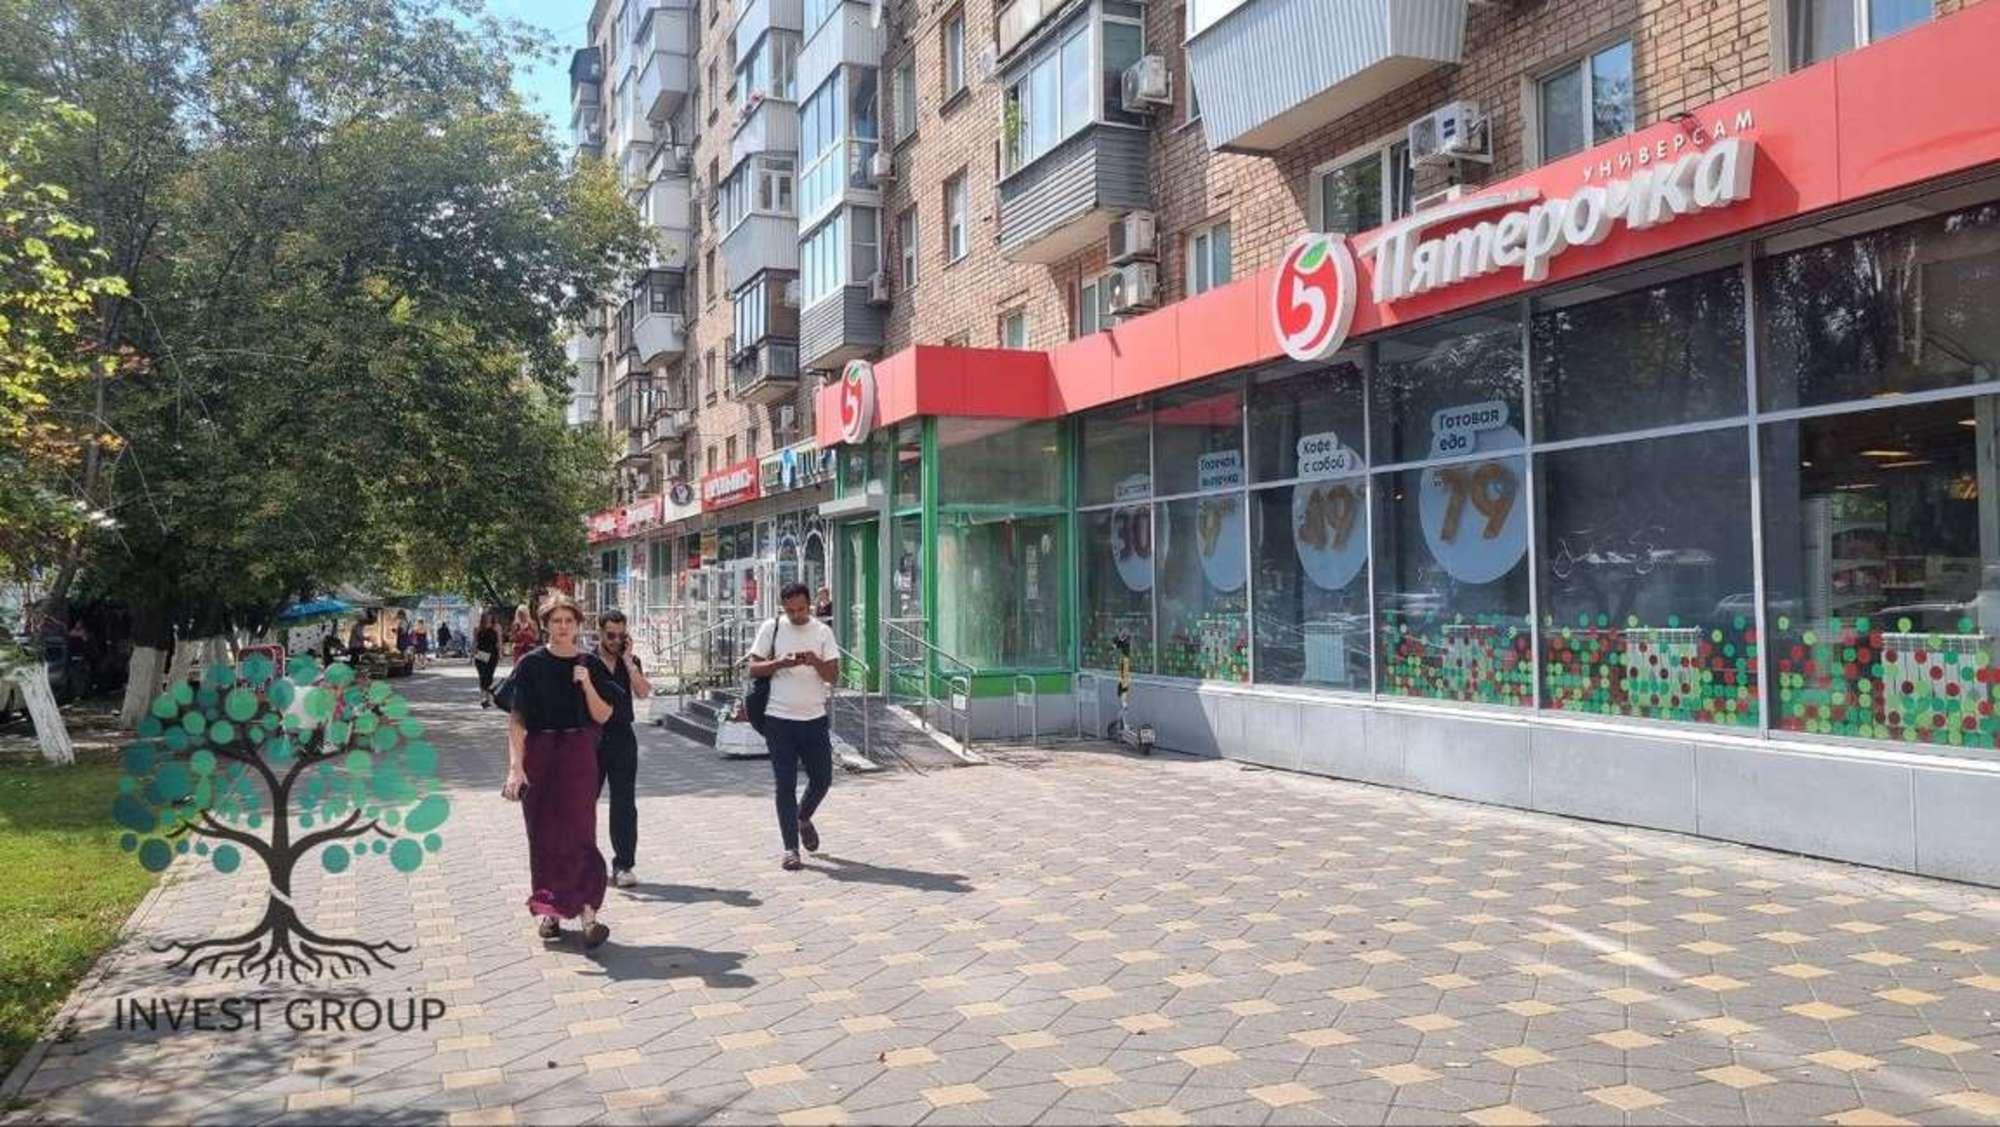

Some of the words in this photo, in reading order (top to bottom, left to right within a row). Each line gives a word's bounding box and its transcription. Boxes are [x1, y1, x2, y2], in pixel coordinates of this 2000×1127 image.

[1582, 108, 1755, 181] УНИВЕРСАМ
[1358, 139, 1757, 305] Пятерочка
[1439, 409, 1500, 434] Готовая
[1302, 439, 1332, 454] Кофе
[1440, 433, 1467, 452] еда
[1303, 461, 1311, 472] с
[1312, 455, 1345, 472] собой
[1438, 463, 1517, 544] 79
